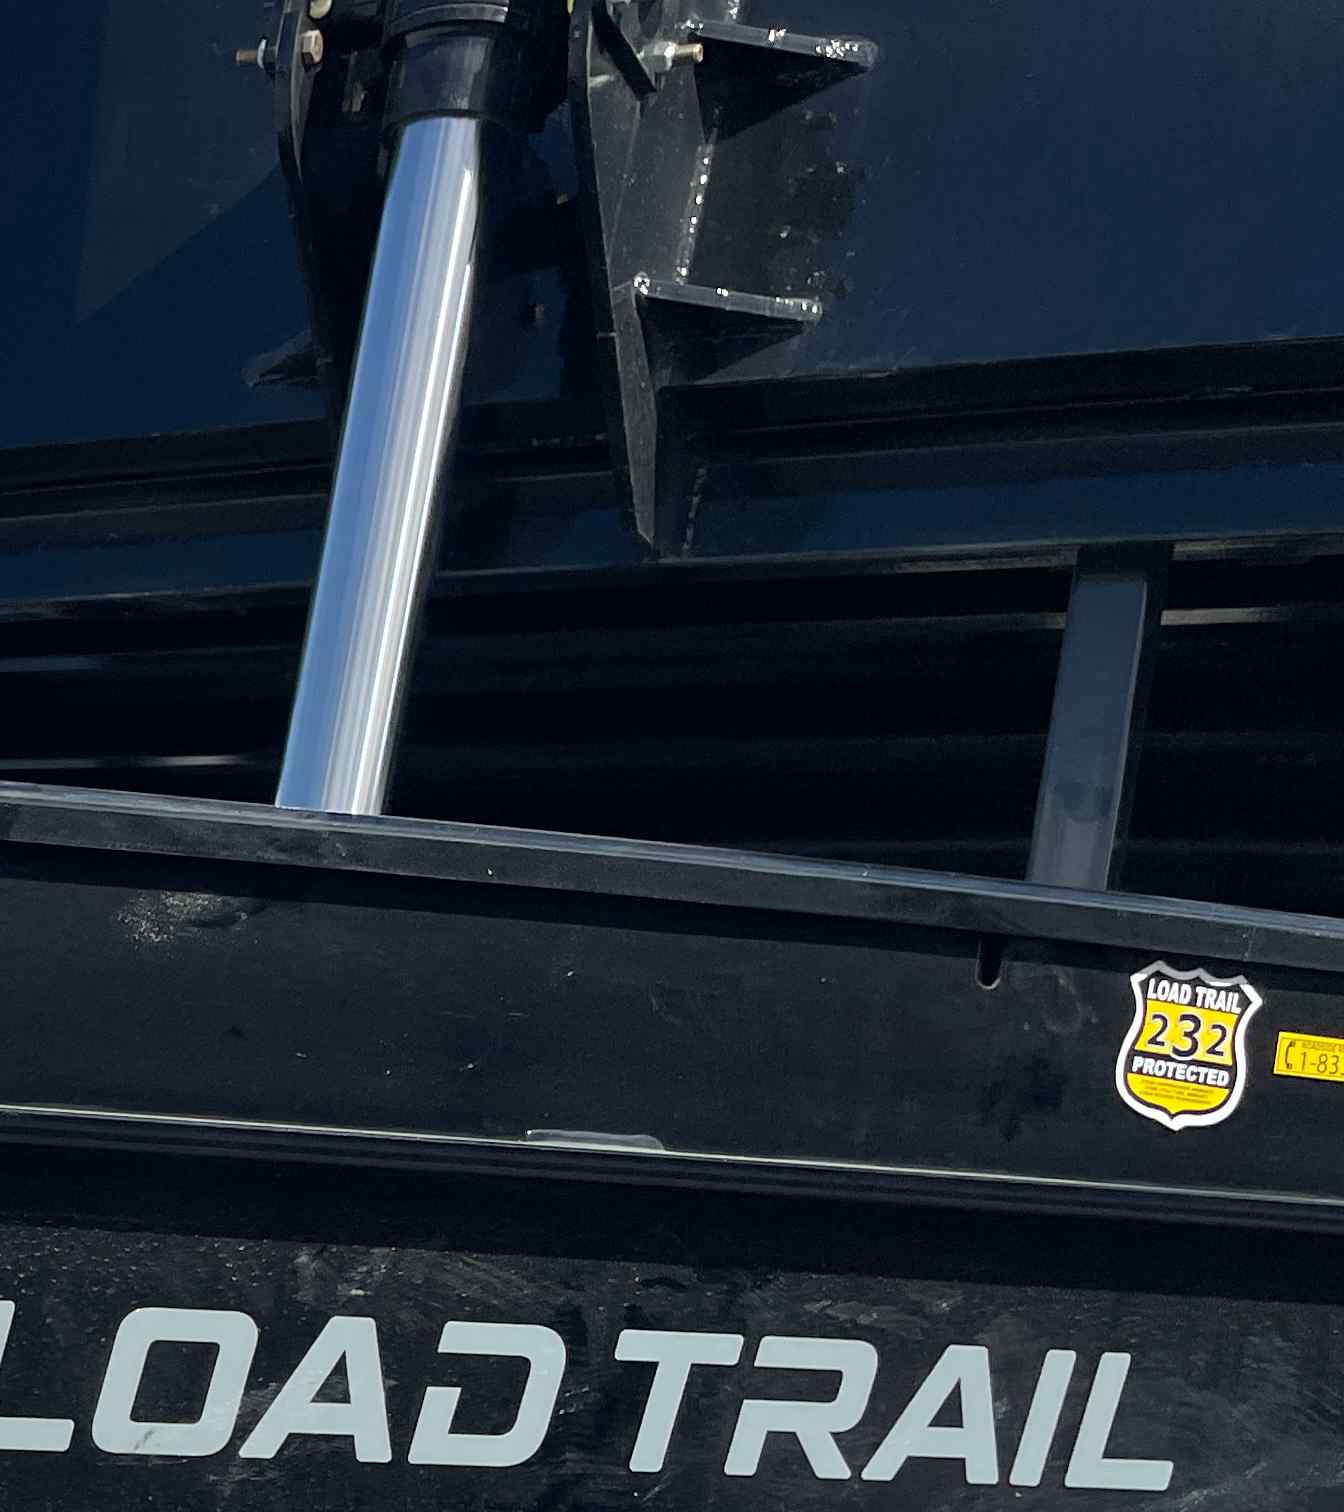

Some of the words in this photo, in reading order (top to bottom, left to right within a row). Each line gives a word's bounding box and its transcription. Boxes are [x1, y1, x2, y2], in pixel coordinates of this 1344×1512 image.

[1147, 978, 1192, 1005] LOAD
[1196, 986, 1242, 1014] TRAIL
[1147, 1013, 1227, 1057] 232
[1132, 1056, 1229, 1087] PROTECTED
